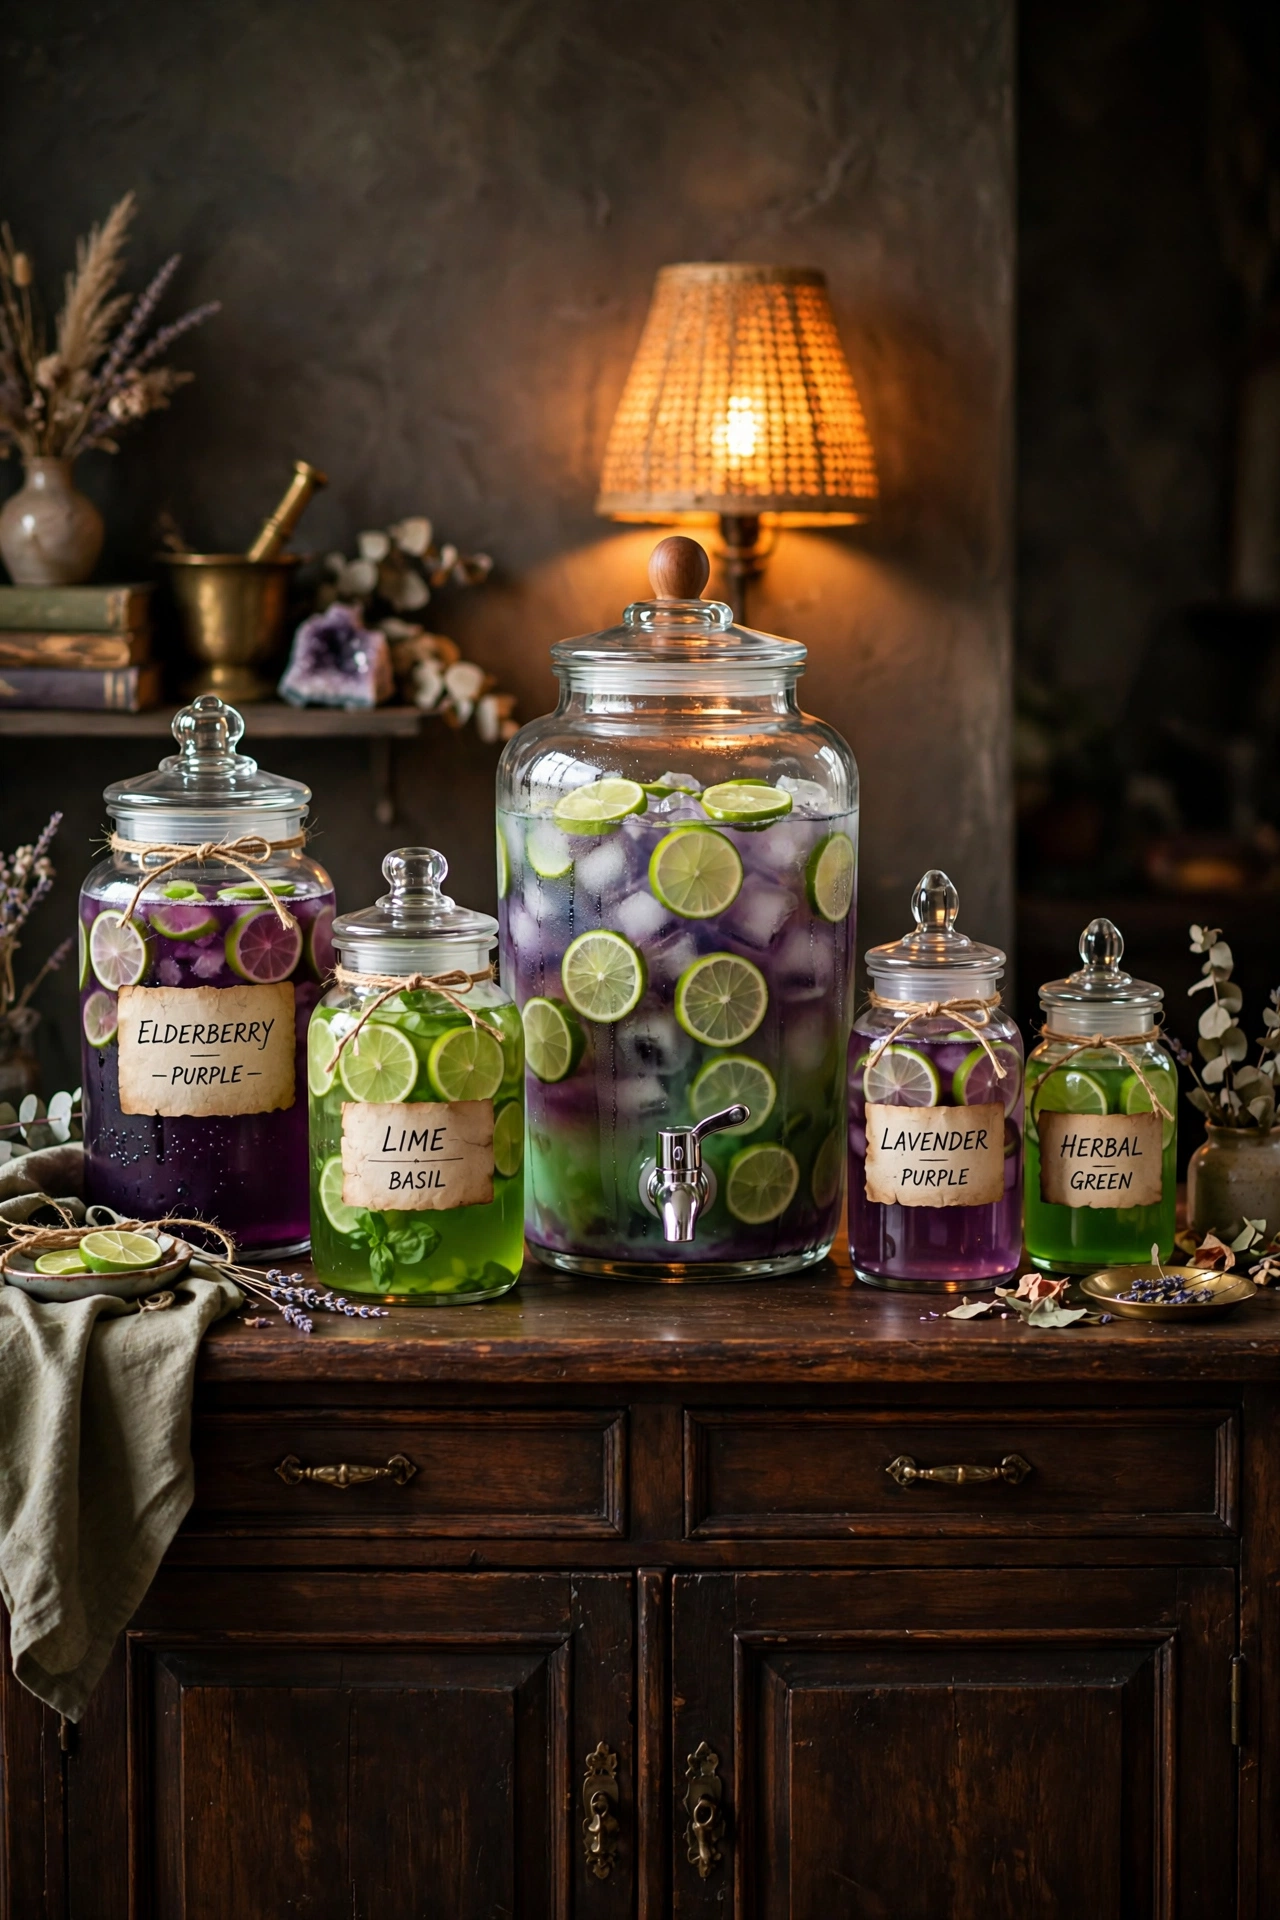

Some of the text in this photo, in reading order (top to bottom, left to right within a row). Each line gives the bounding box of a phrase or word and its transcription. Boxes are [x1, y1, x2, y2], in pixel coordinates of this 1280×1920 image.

[137, 1018, 275, 1050] ELDERBERRY
[171, 1065, 244, 1085] PURPLE
[382, 1125, 447, 1152] LIME
[881, 1127, 988, 1151] LAVENDER
[1060, 1134, 1143, 1158] HERBAL
[388, 1170, 446, 1190] BASIL
[901, 1168, 970, 1187] PURPLE
[1070, 1170, 1133, 1190] GREEN
